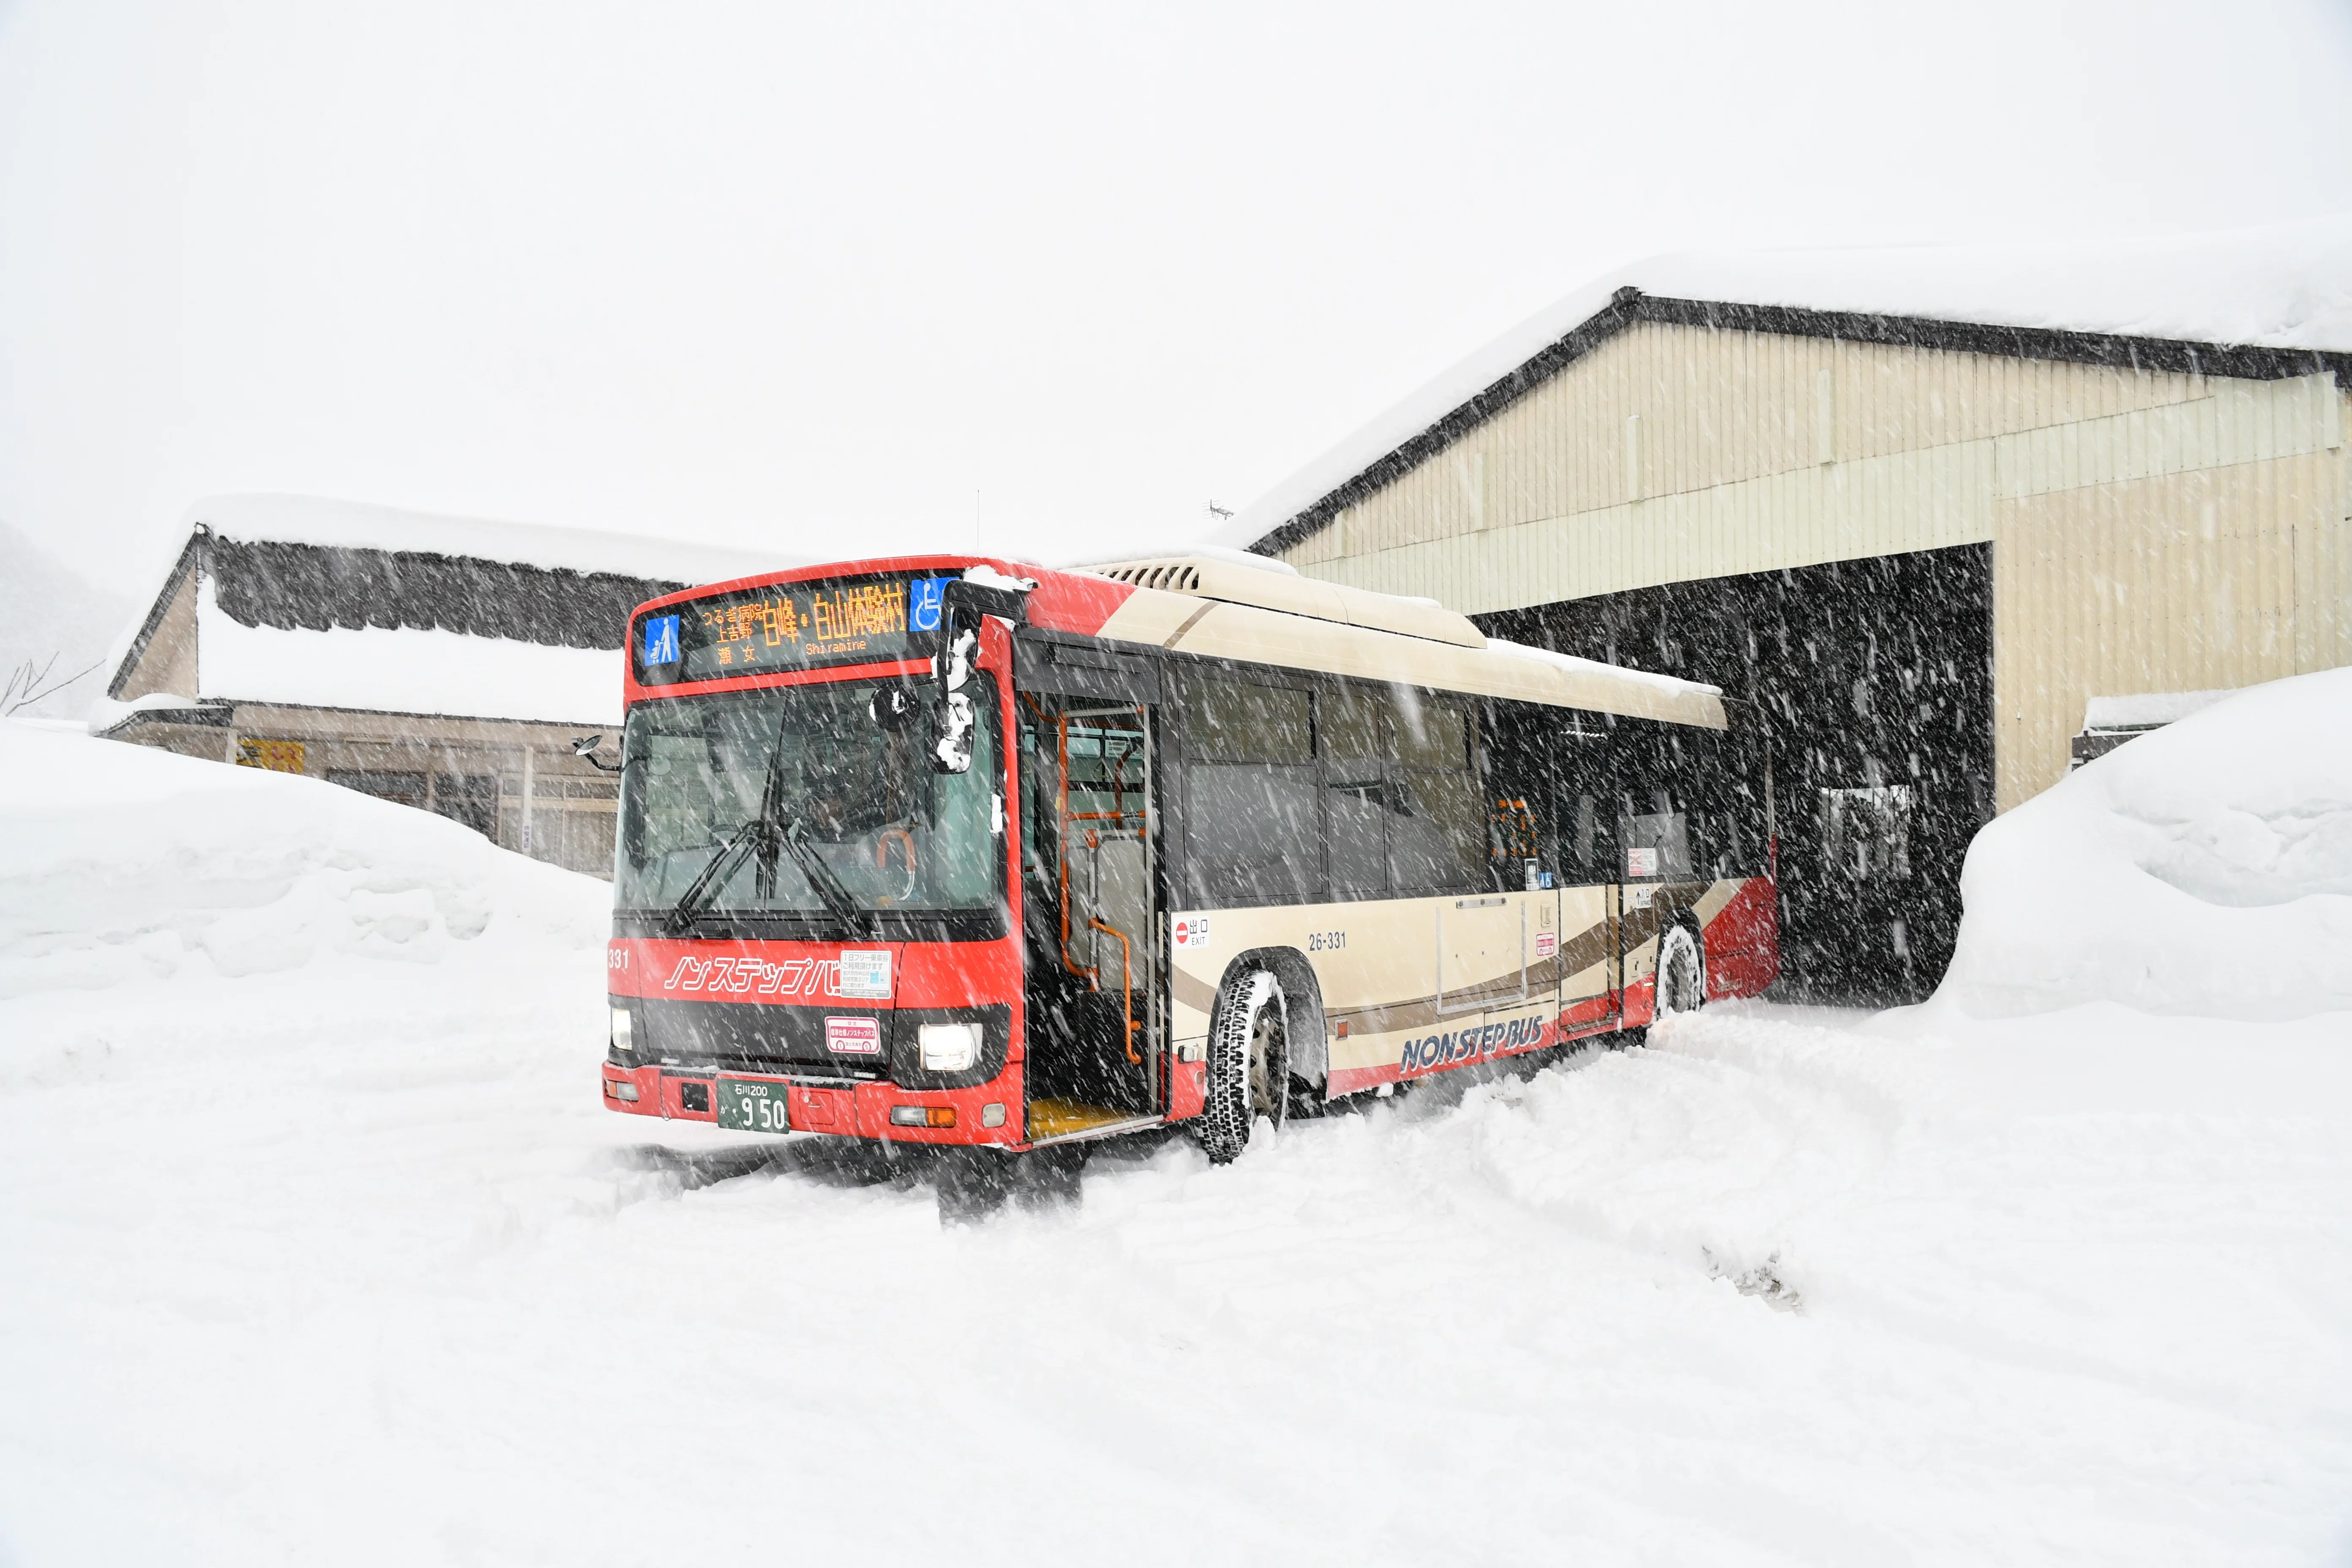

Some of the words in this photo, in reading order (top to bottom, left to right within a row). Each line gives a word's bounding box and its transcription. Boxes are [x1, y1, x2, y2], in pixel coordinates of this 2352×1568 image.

[702, 604, 763, 626] つるぎ病院
[716, 622, 754, 643] 上吉野
[806, 639, 866, 655] Shiramine
[1190, 919, 1208, 934] 出口
[1192, 936, 1206, 945] EXIT
[1309, 931, 1346, 951] 26-331
[608, 948, 629, 969] 331
[843, 962, 883, 970] ご利用頂けます
[664, 956, 841, 996] ノンステップバ
